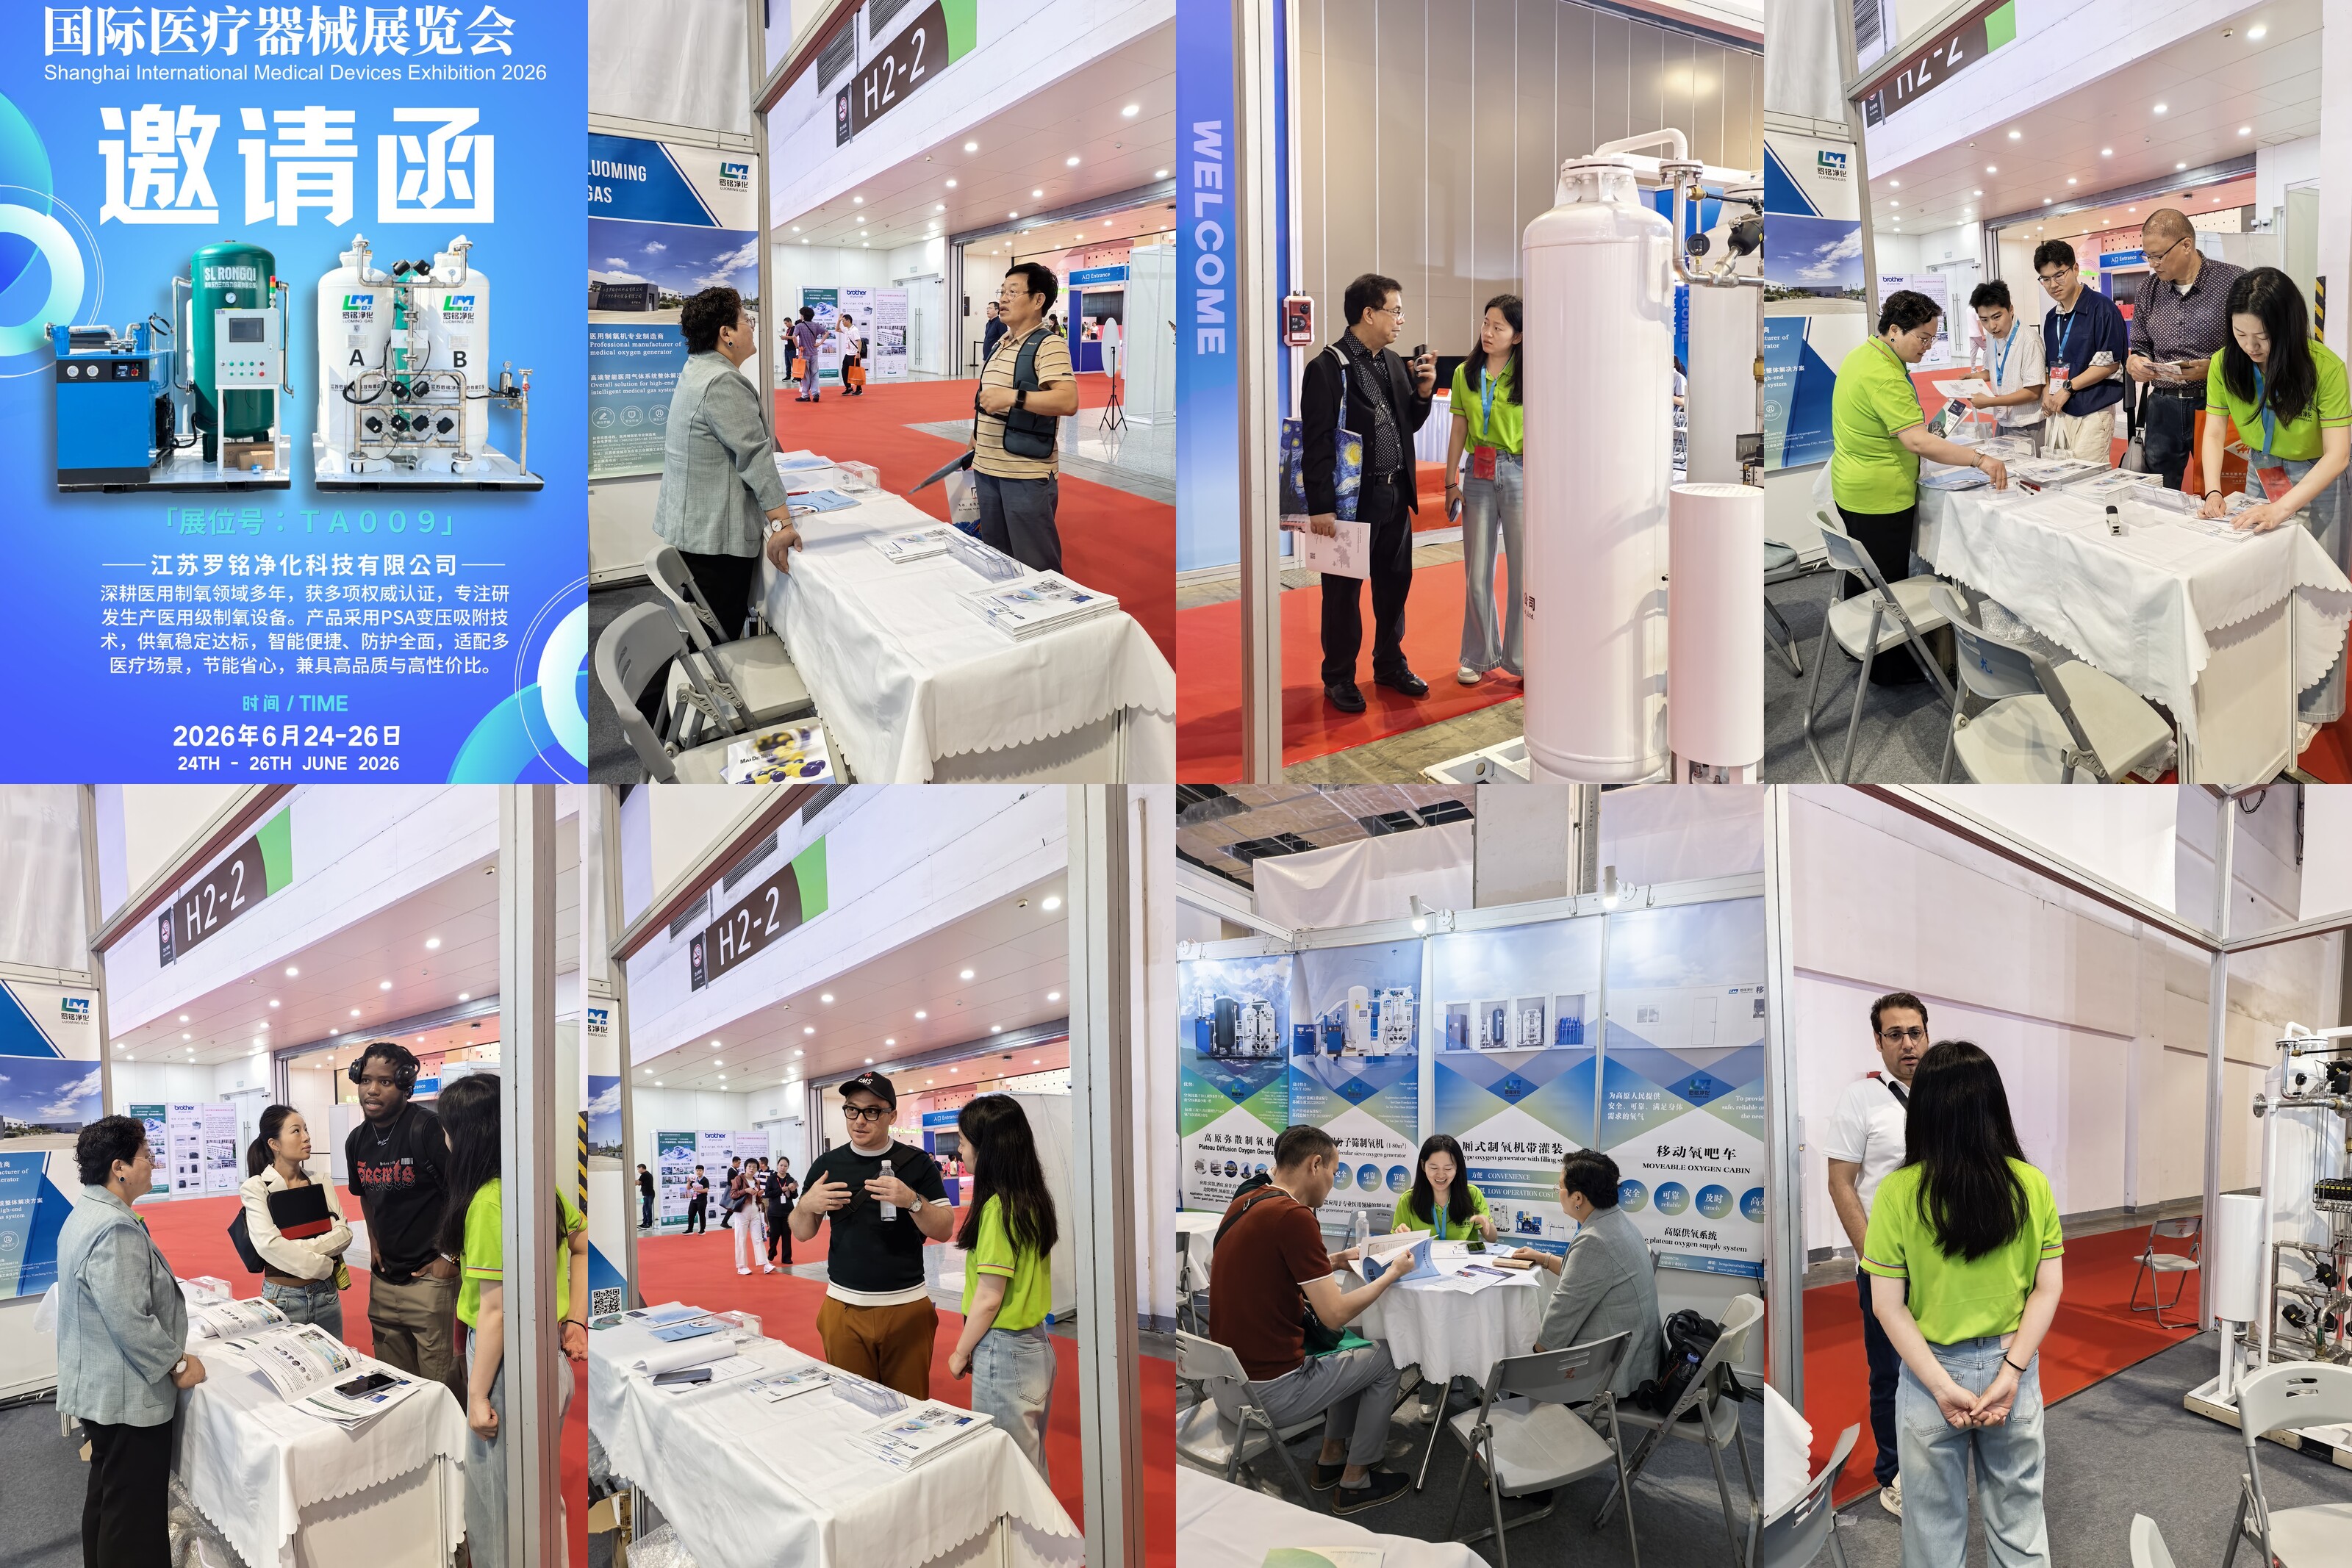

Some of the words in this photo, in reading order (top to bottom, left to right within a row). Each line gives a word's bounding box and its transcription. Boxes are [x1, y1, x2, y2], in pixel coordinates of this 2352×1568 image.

[45, 5, 516, 56] 国际医疗器械展览会
[45, 65, 129, 84] Shanghai
[137, 65, 247, 80] International
[254, 65, 323, 80] Medical
[330, 65, 401, 80] Devices
[409, 65, 495, 80] Exhibition
[502, 65, 547, 80] 2026
[864, 27, 925, 118] H2-2
[98, 104, 495, 227] 邀请函
[1193, 121, 1225, 355] WELCOME
[204, 267, 216, 281] SL
[218, 267, 257, 282] RONGQI
[349, 349, 365, 366] A
[453, 351, 467, 367] B
[151, 553, 456, 576] 江苏罗铭净化科技有限公司
[101, 584, 509, 603] 深耕医用制氧领域多年，获多项权威认证，专注研
[101, 608, 509, 626] 发生产医用级制氧设备。产品采用PSA变压吸附技
[101, 632, 509, 650] 术，供氧稳定达标，智能便捷、防护全面，适配多
[110, 656, 490, 675] 医疗场景，节能省心，兼具高品质与高性价比。
[243, 695, 279, 712] 时间
[287, 695, 294, 711] /
[299, 695, 348, 711] TIME
[173, 724, 400, 747] 2026年6月24-26日
[178, 756, 220, 770] 24TH
[249, 756, 292, 770] 26TH
[302, 756, 348, 770] JUNE
[358, 756, 400, 770] 2026
[186, 860, 245, 941] H2-2
[719, 886, 780, 965] H2-2
[1608, 1091, 1661, 1101] 为高原人民提供
[1607, 1102, 1683, 1112] 安全、可靠、满足身体
[1607, 1112, 1645, 1121] 需求的氧气
[1205, 1133, 1274, 1147] 高原弥散制氧机
[1463, 1140, 1563, 1154] 厢式制氧机带灌装
[1199, 1143, 1216, 1151] Plateau
[1216, 1145, 1237, 1153] Diffusion
[1238, 1147, 1255, 1155] Oxygen
[1656, 1145, 1737, 1161] 移动氧吧车
[1541, 1156, 1557, 1165] filling
[1642, 1162, 1686, 1171] MOVEABLE
[1688, 1165, 1721, 1173] OXYGEN
[1363, 1171, 1376, 1179] 可靠
[1394, 1173, 1405, 1182] 节能
[1488, 1173, 1531, 1181] CONVENIENCE
[1503, 1189, 1538, 1197] OPERATION
[1624, 1188, 1641, 1198] 安全
[1663, 1190, 1679, 1201] 可靠
[1704, 1193, 1723, 1203] 及时
[1704, 1204, 1721, 1213] timely
[1664, 1226, 1718, 1240] 高原供氧系统
[1650, 1237, 1673, 1246] plateau
[1674, 1240, 1698, 1248] oxygen
[1699, 1242, 1721, 1252] supply
